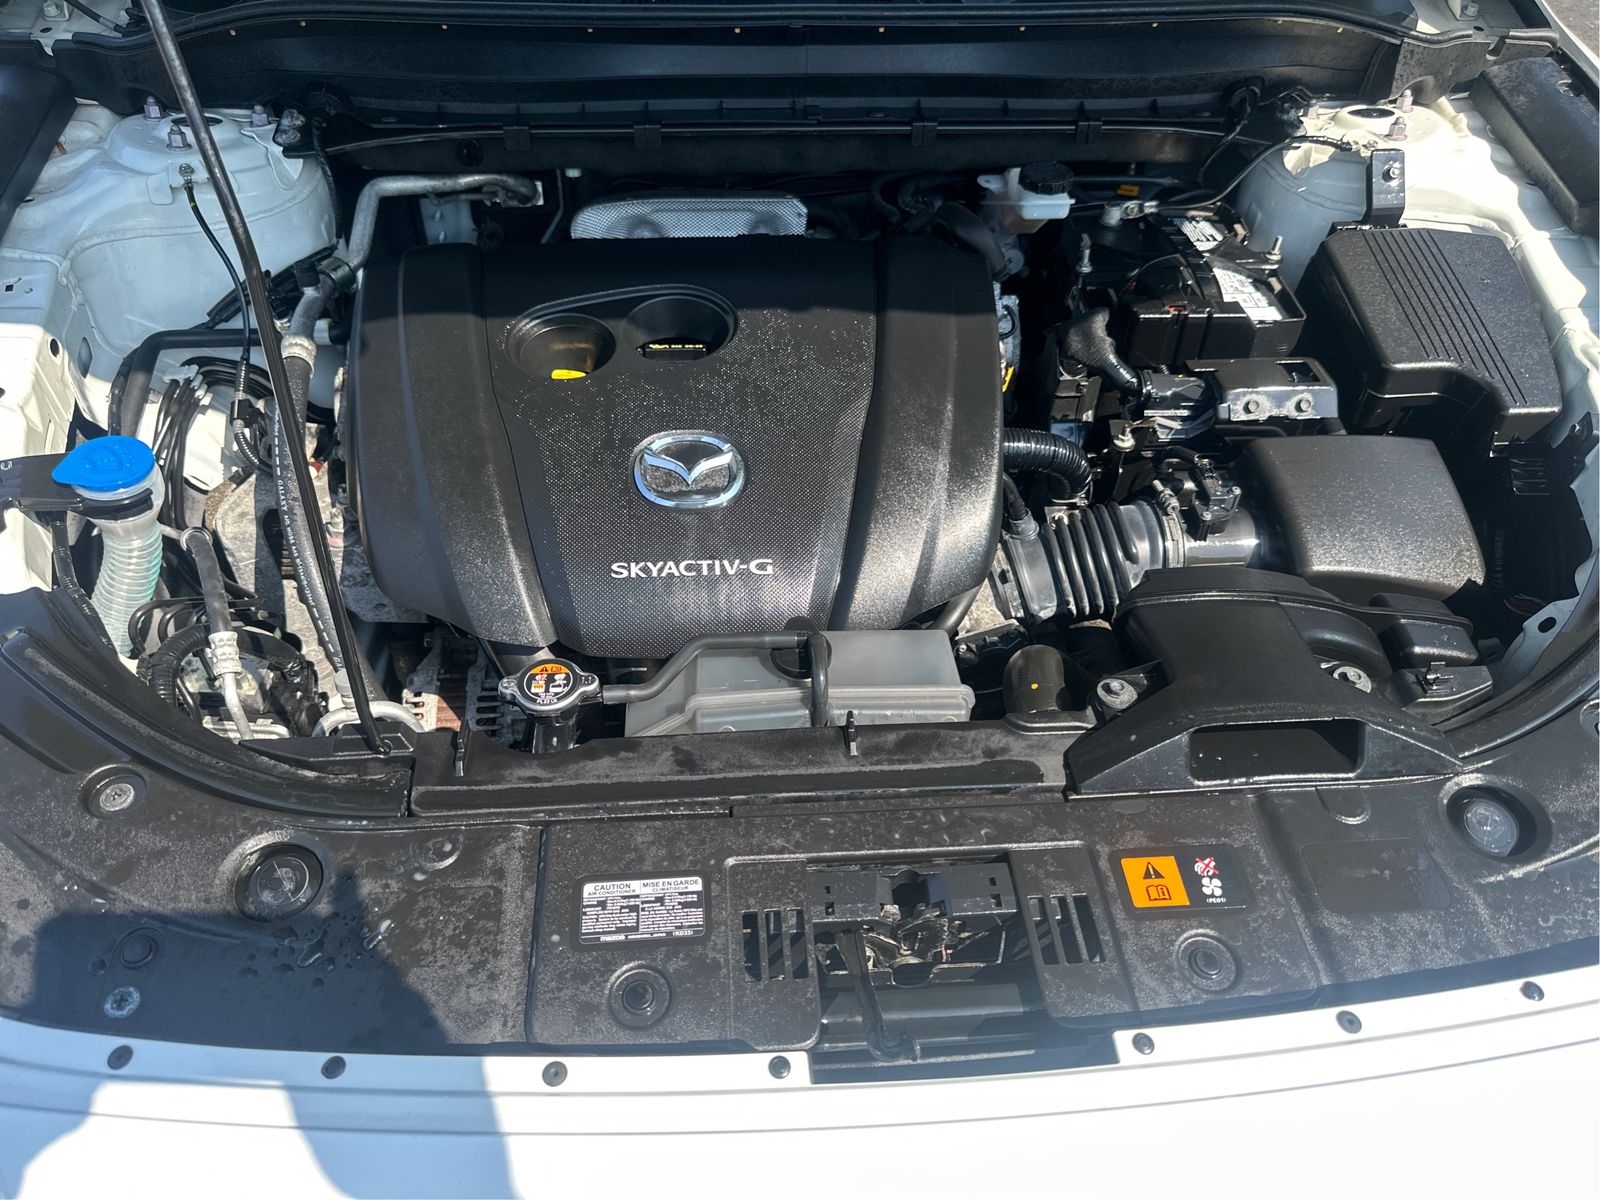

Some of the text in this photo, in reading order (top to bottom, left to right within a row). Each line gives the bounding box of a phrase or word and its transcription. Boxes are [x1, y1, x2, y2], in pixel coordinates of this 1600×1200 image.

[276, 480, 287, 512] GALAXY
[610, 558, 774, 579] SKYACTIV-G
[594, 883, 631, 891] CAUTION
